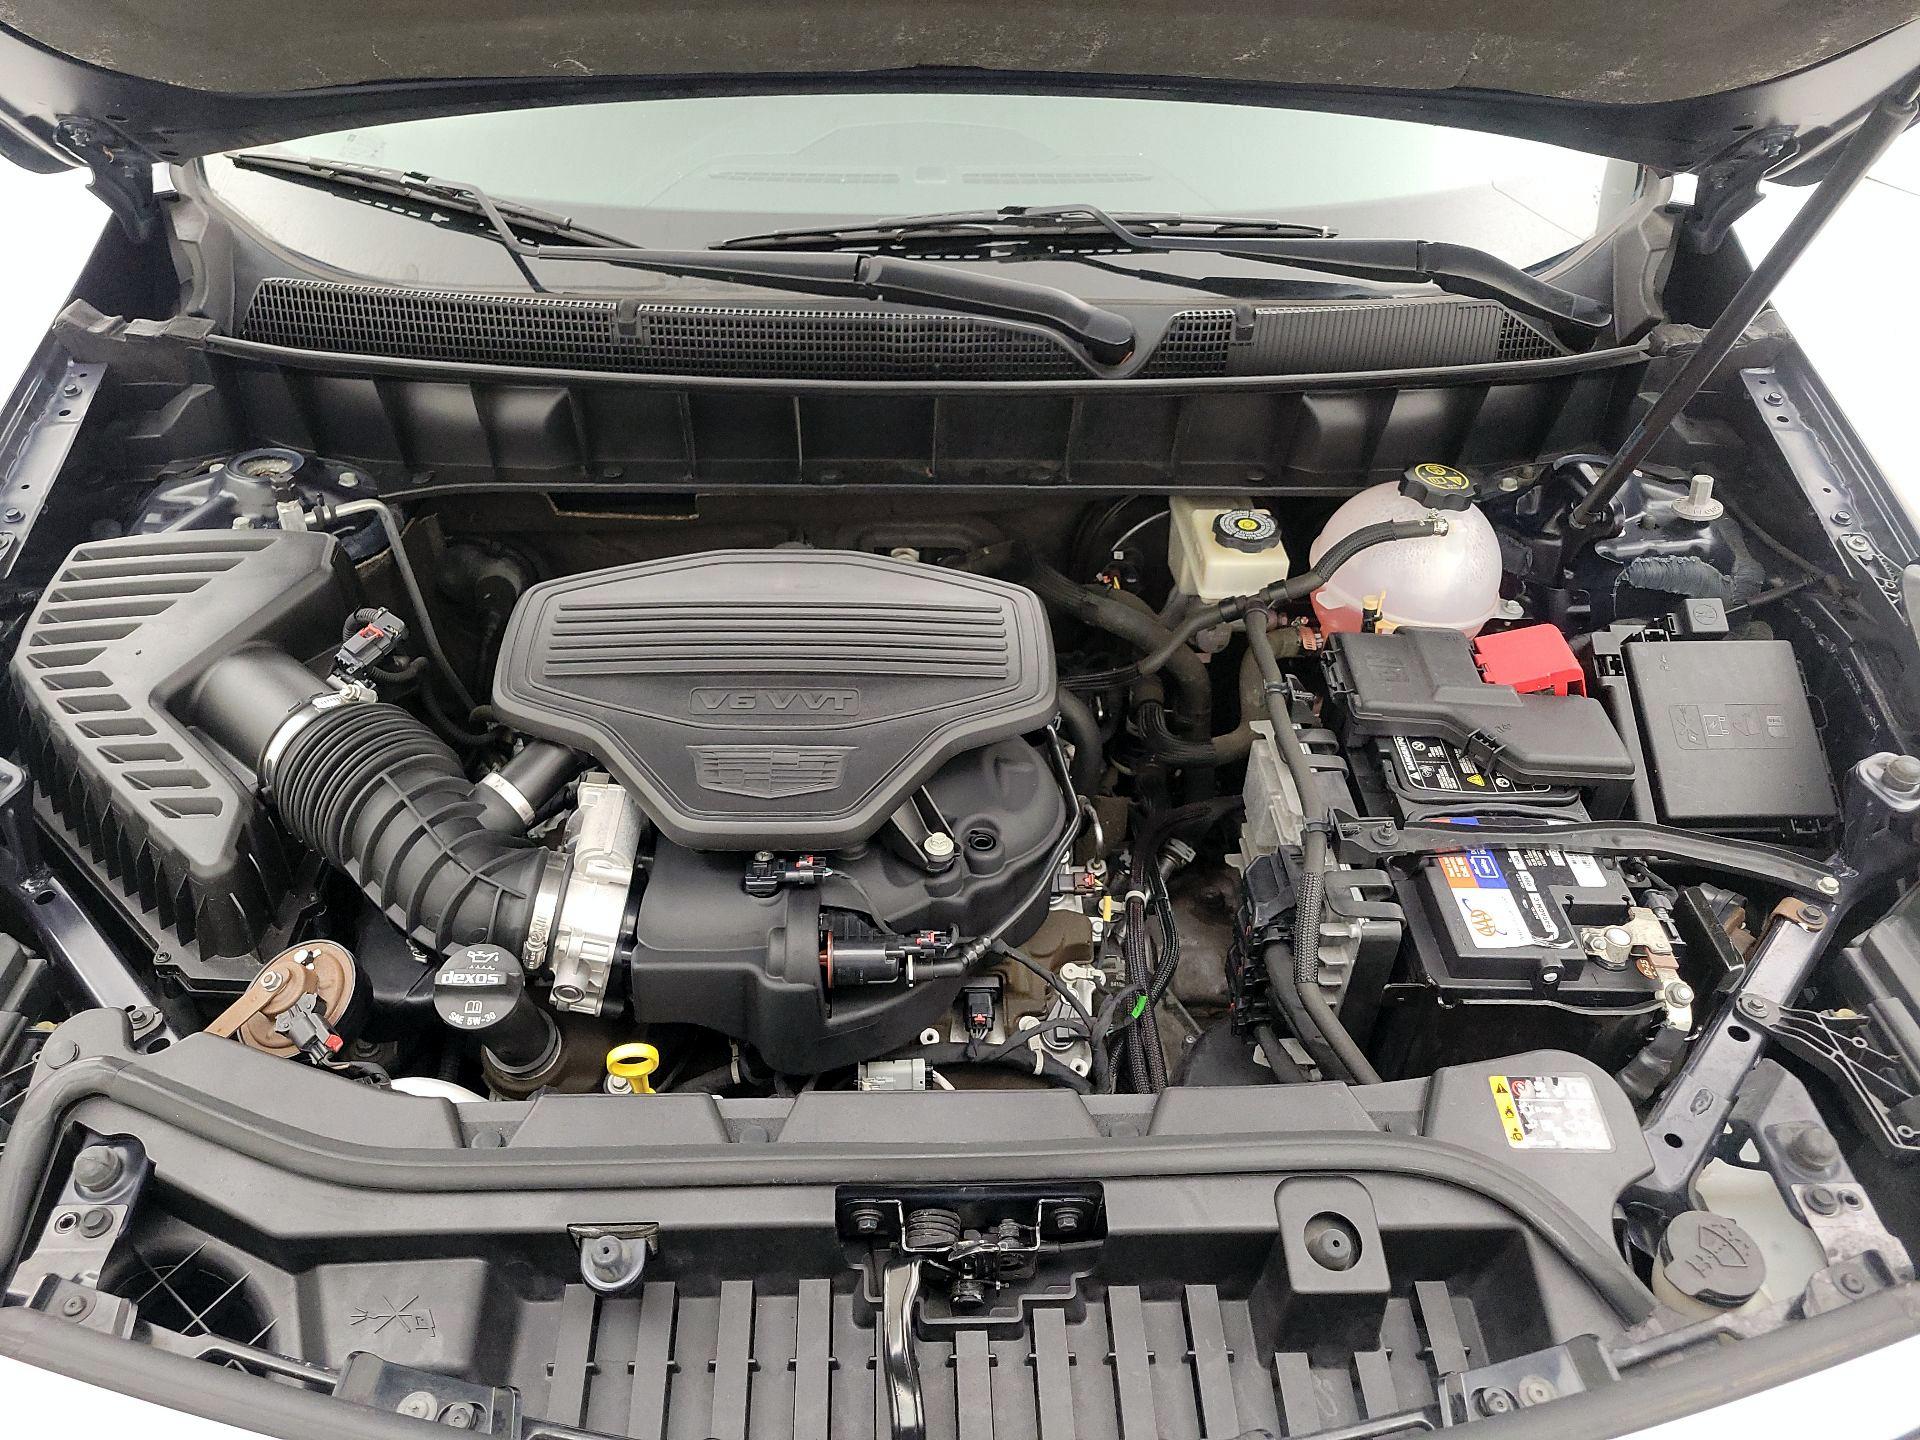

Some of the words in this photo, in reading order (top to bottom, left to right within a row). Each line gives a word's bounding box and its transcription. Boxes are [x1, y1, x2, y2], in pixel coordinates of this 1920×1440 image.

[697, 692, 756, 710] V6
[765, 692, 853, 711] VVT
[441, 971, 501, 985] dexos
[448, 1011, 465, 1025] SAE
[466, 1011, 497, 1026] 5W-30
